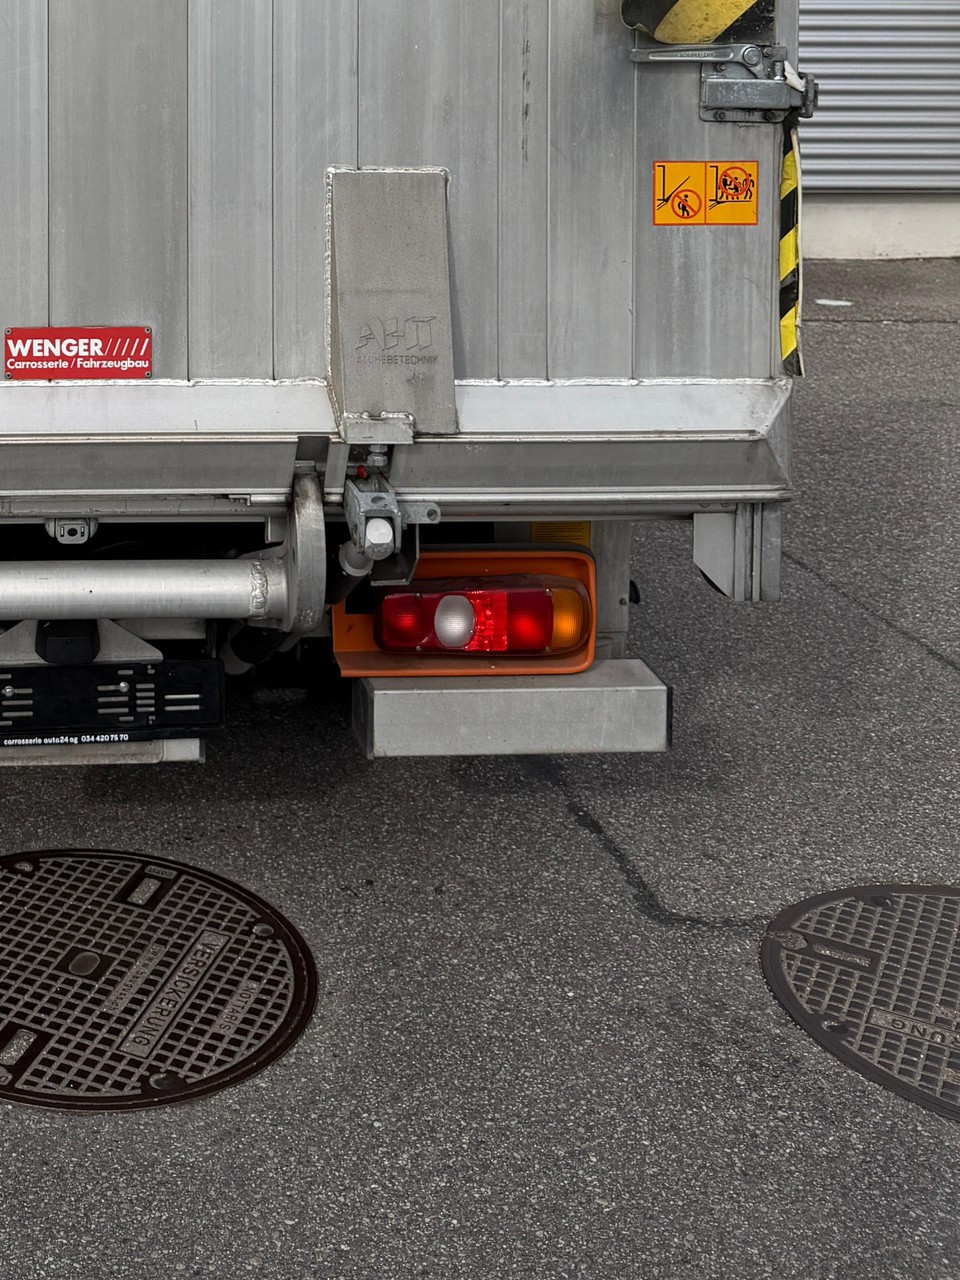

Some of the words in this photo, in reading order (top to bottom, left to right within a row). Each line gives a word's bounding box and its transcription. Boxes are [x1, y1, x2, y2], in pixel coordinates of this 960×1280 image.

[7, 338, 103, 357] WENGER
[6, 358, 69, 369] Carrosserie
[76, 357, 149, 370] Fahrzeugbau
[3, 736, 42, 746] carrosserie
[43, 735, 69, 744] auto24
[69, 736, 79, 745] ag
[80, 734, 95, 743] 034
[95, 734, 110, 742] 420
[119, 733, 129, 741] 70
[134, 941, 219, 1048] VERSICKERUNG
[218, 982, 257, 1031] NOTTARIS
